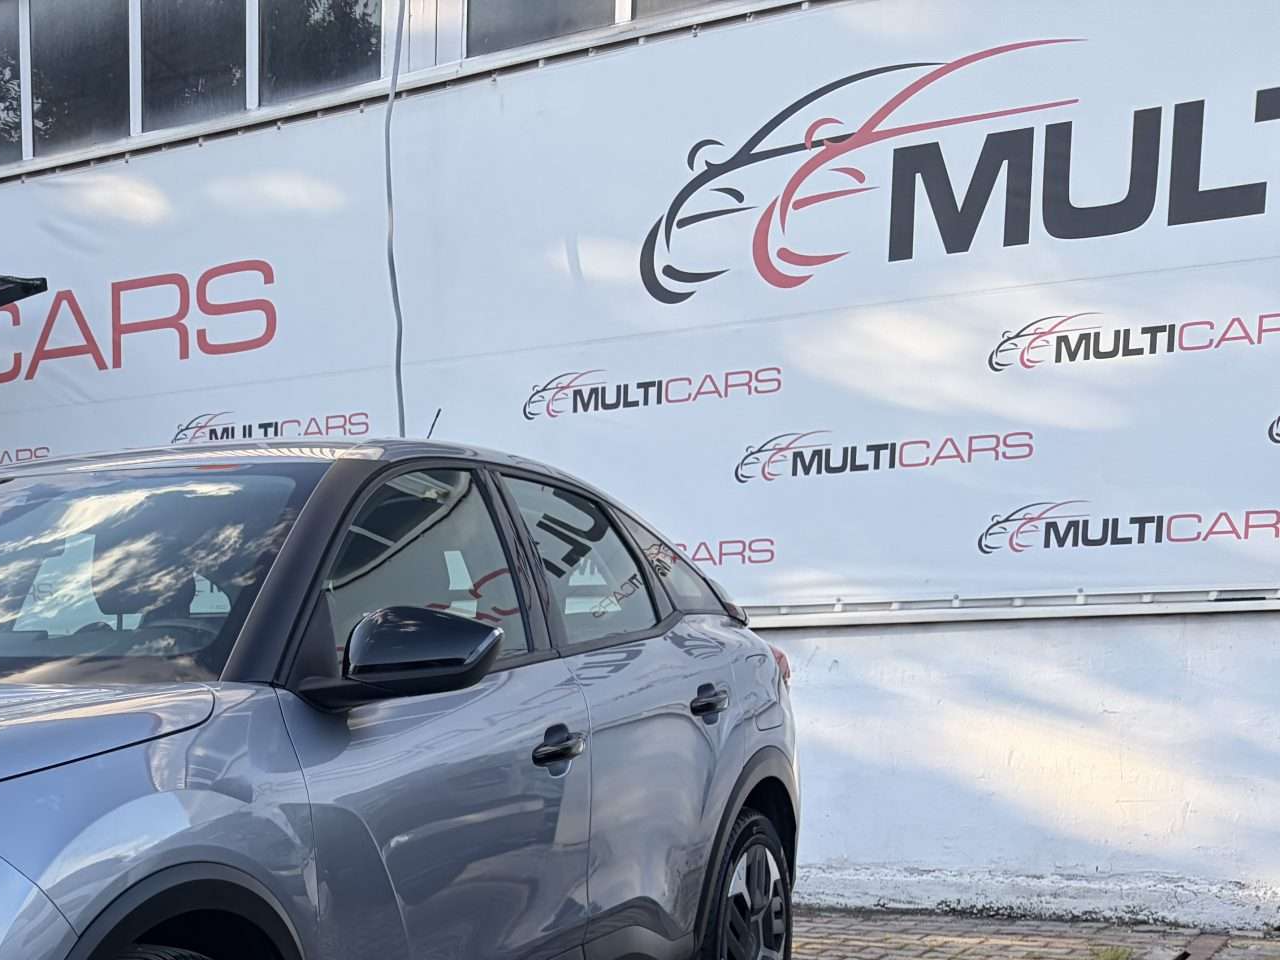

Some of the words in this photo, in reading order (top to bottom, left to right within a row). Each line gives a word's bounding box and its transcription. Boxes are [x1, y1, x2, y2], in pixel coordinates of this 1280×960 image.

[888, 86, 1280, 262] MUL
[572, 367, 782, 413] MULTICARS
[791, 431, 1035, 476] MULTICARS
